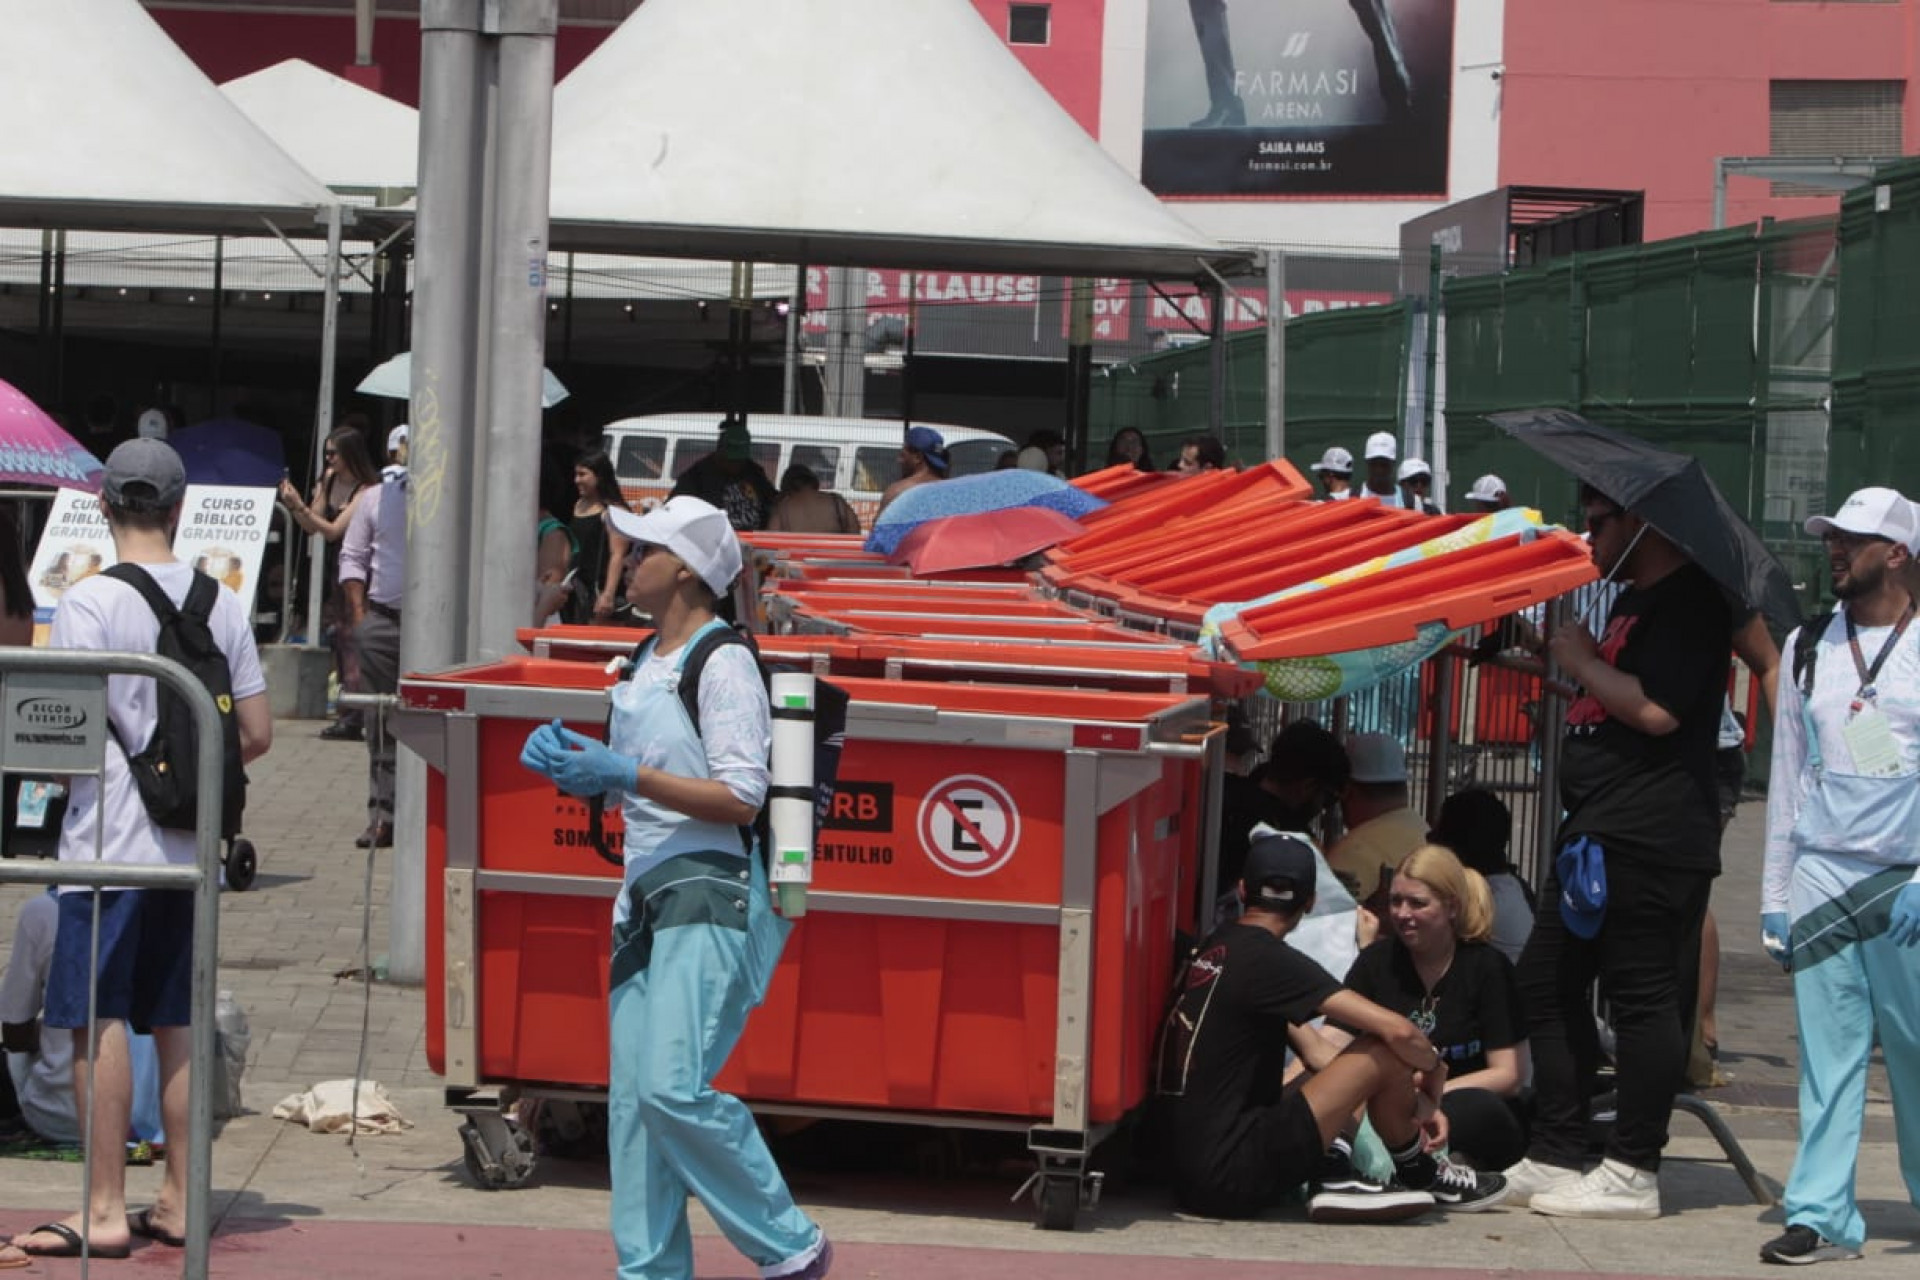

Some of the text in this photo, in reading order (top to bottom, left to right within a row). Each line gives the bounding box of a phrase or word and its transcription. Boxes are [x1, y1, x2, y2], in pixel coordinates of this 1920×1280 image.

[1234, 69, 1358, 96] FARMASI
[1261, 101, 1322, 119] ARENA
[1259, 141, 1325, 154] SAIBA MAIS
[899, 272, 1034, 302] KLAUSS
[202, 497, 255, 510] CURSO
[193, 510, 257, 526] BÍBLICO
[182, 526, 261, 542] GRATUITO
[553, 828, 626, 850] SOMNT
